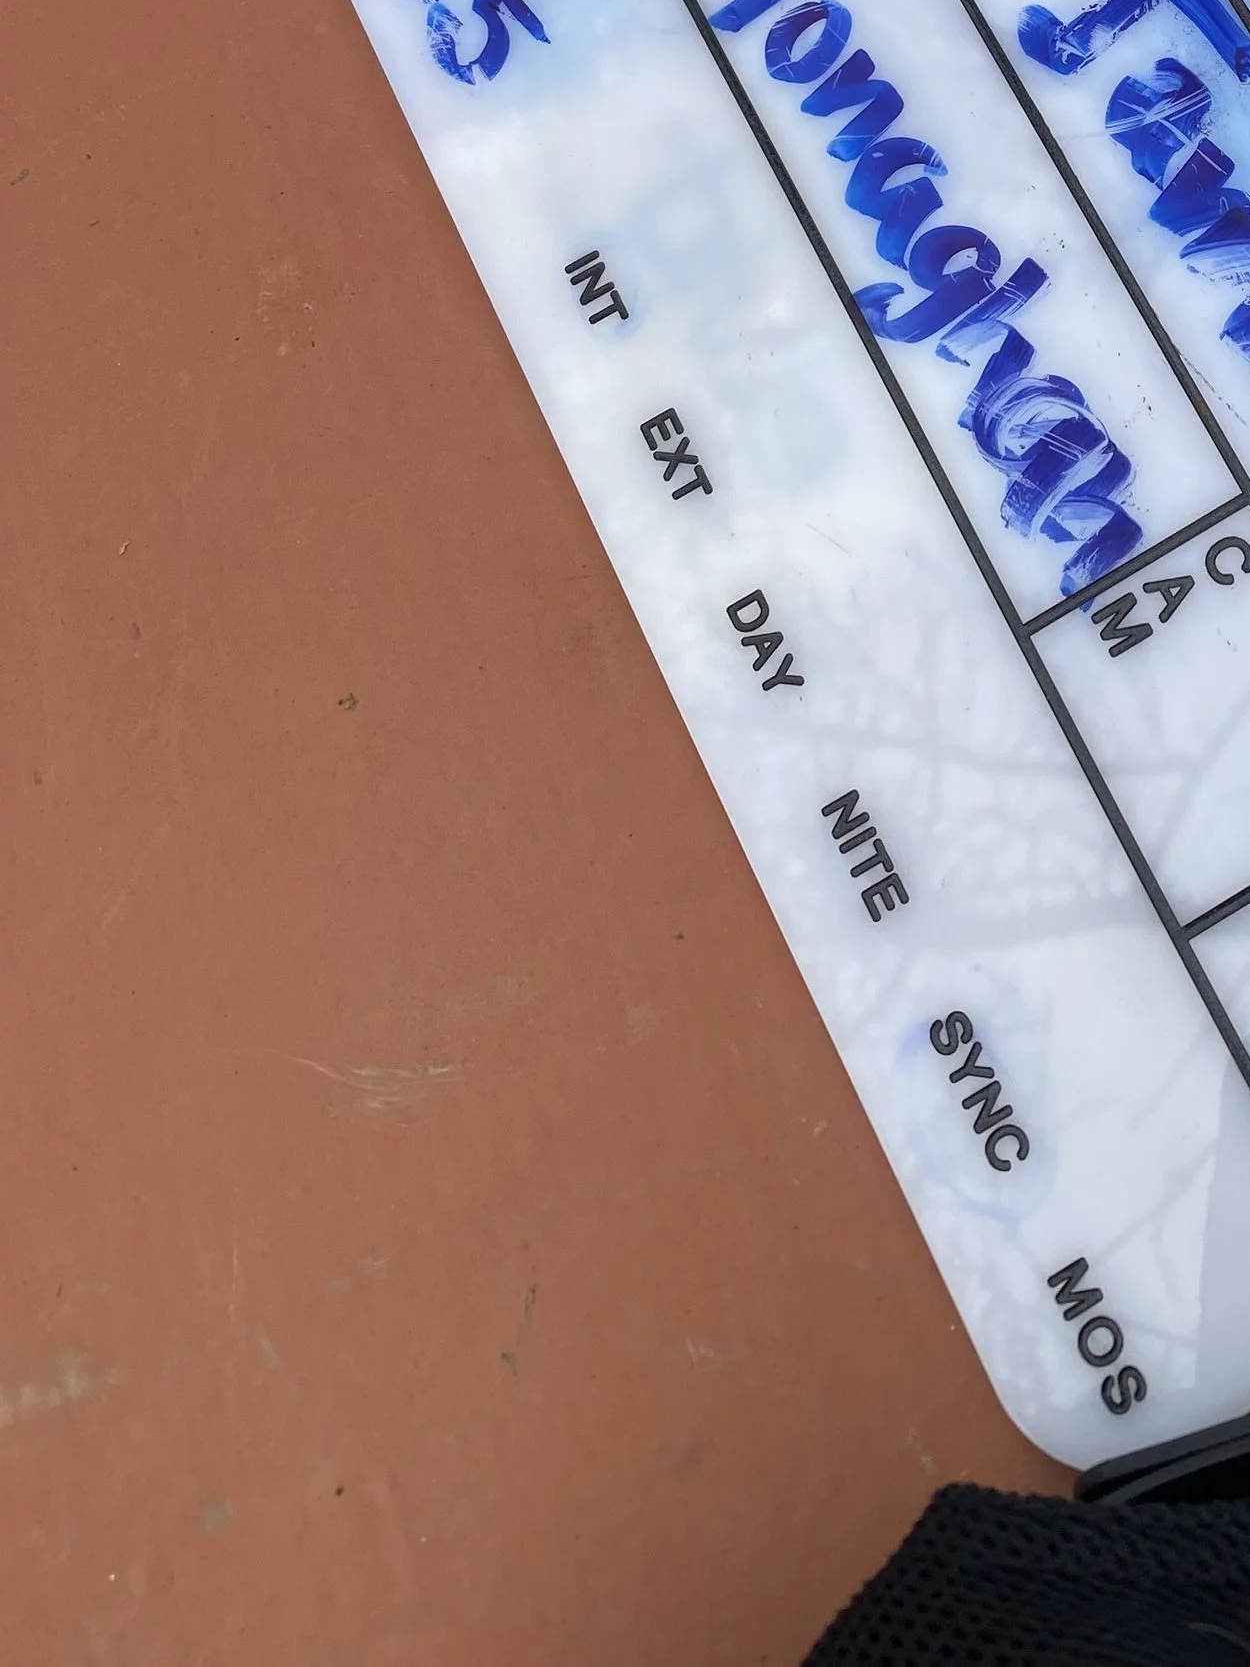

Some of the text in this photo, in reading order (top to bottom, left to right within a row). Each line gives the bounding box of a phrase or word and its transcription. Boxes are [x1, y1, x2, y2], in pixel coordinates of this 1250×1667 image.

[564, 250, 1148, 1415] INT EXT DAY NITE SYNC MOS
